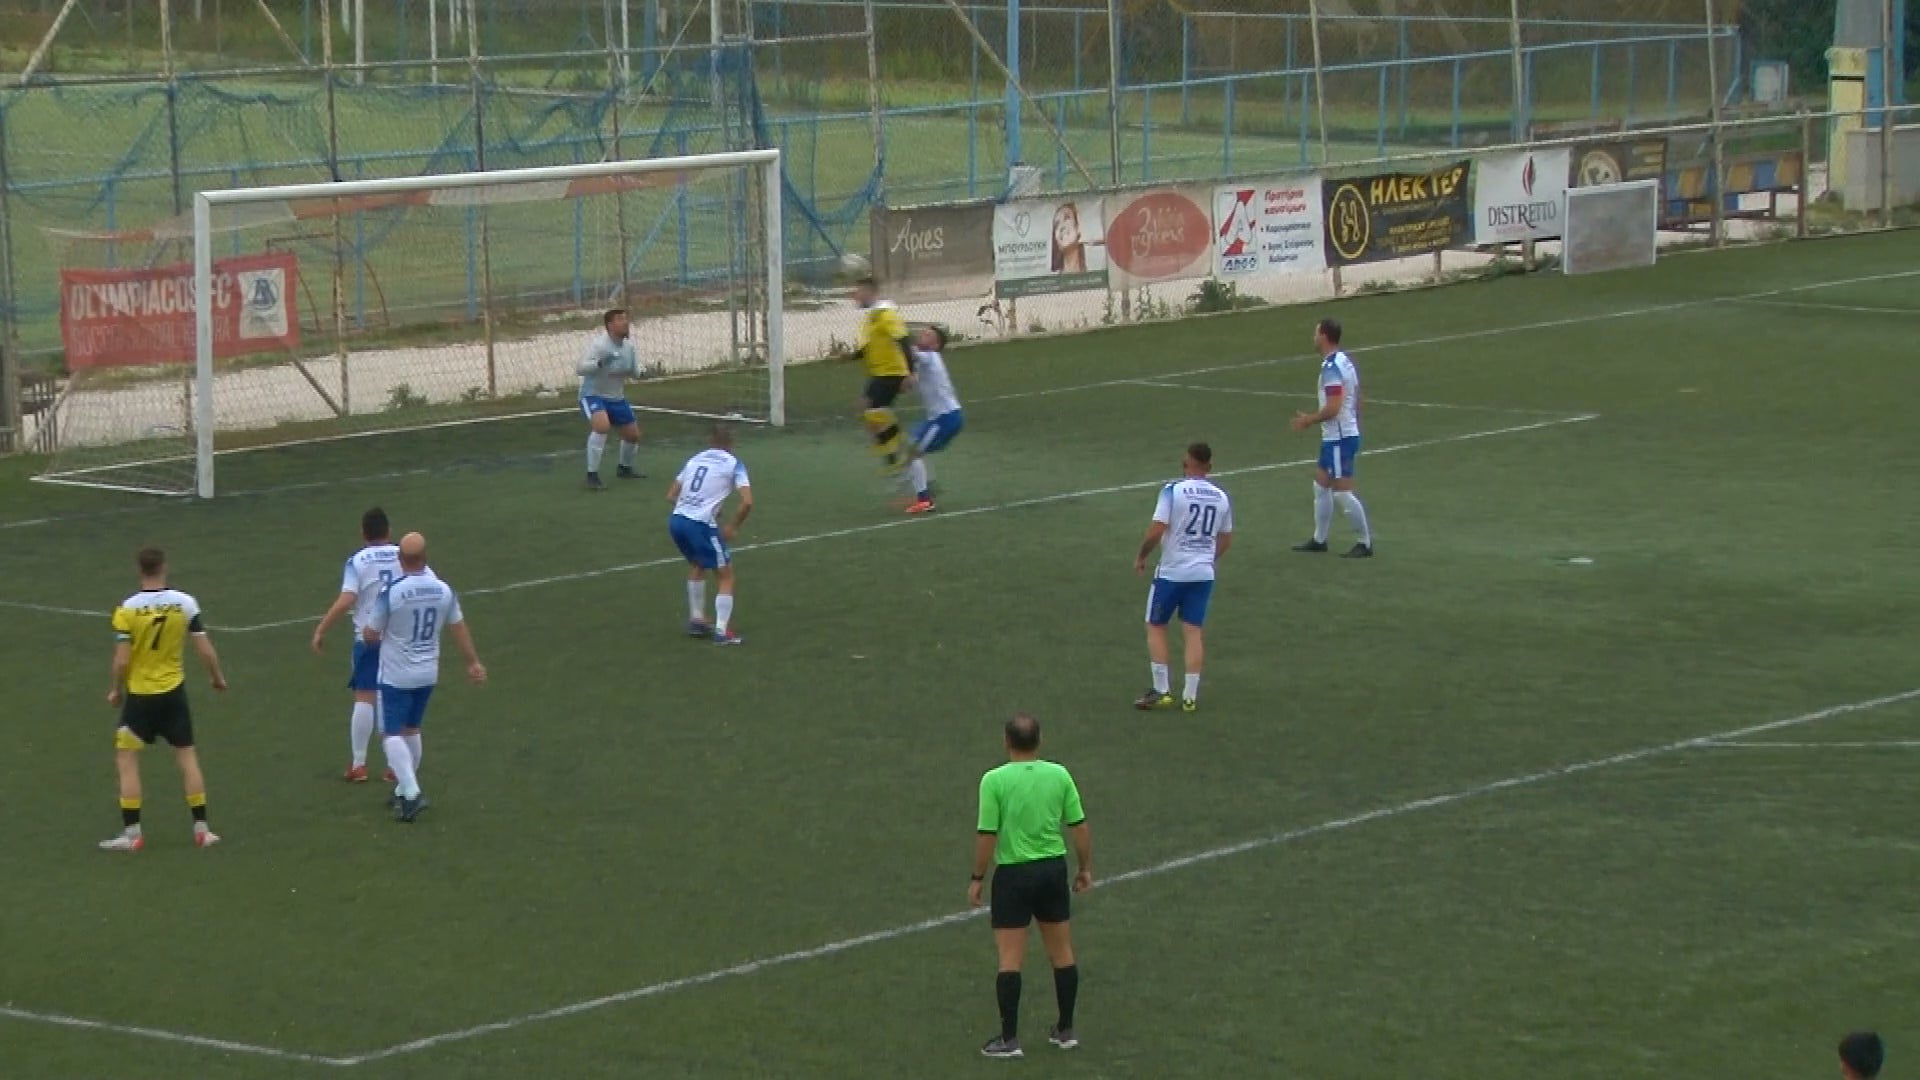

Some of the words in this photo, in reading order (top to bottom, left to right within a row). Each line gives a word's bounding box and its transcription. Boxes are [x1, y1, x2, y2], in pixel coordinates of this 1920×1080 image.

[1488, 200, 1557, 229] DISTRETTO
[70, 275, 197, 321] OLYMPIACOS
[690, 466, 708, 493] 8
[1185, 503, 1217, 536] 20
[151, 615, 168, 650] 7
[412, 607, 438, 642] 18
